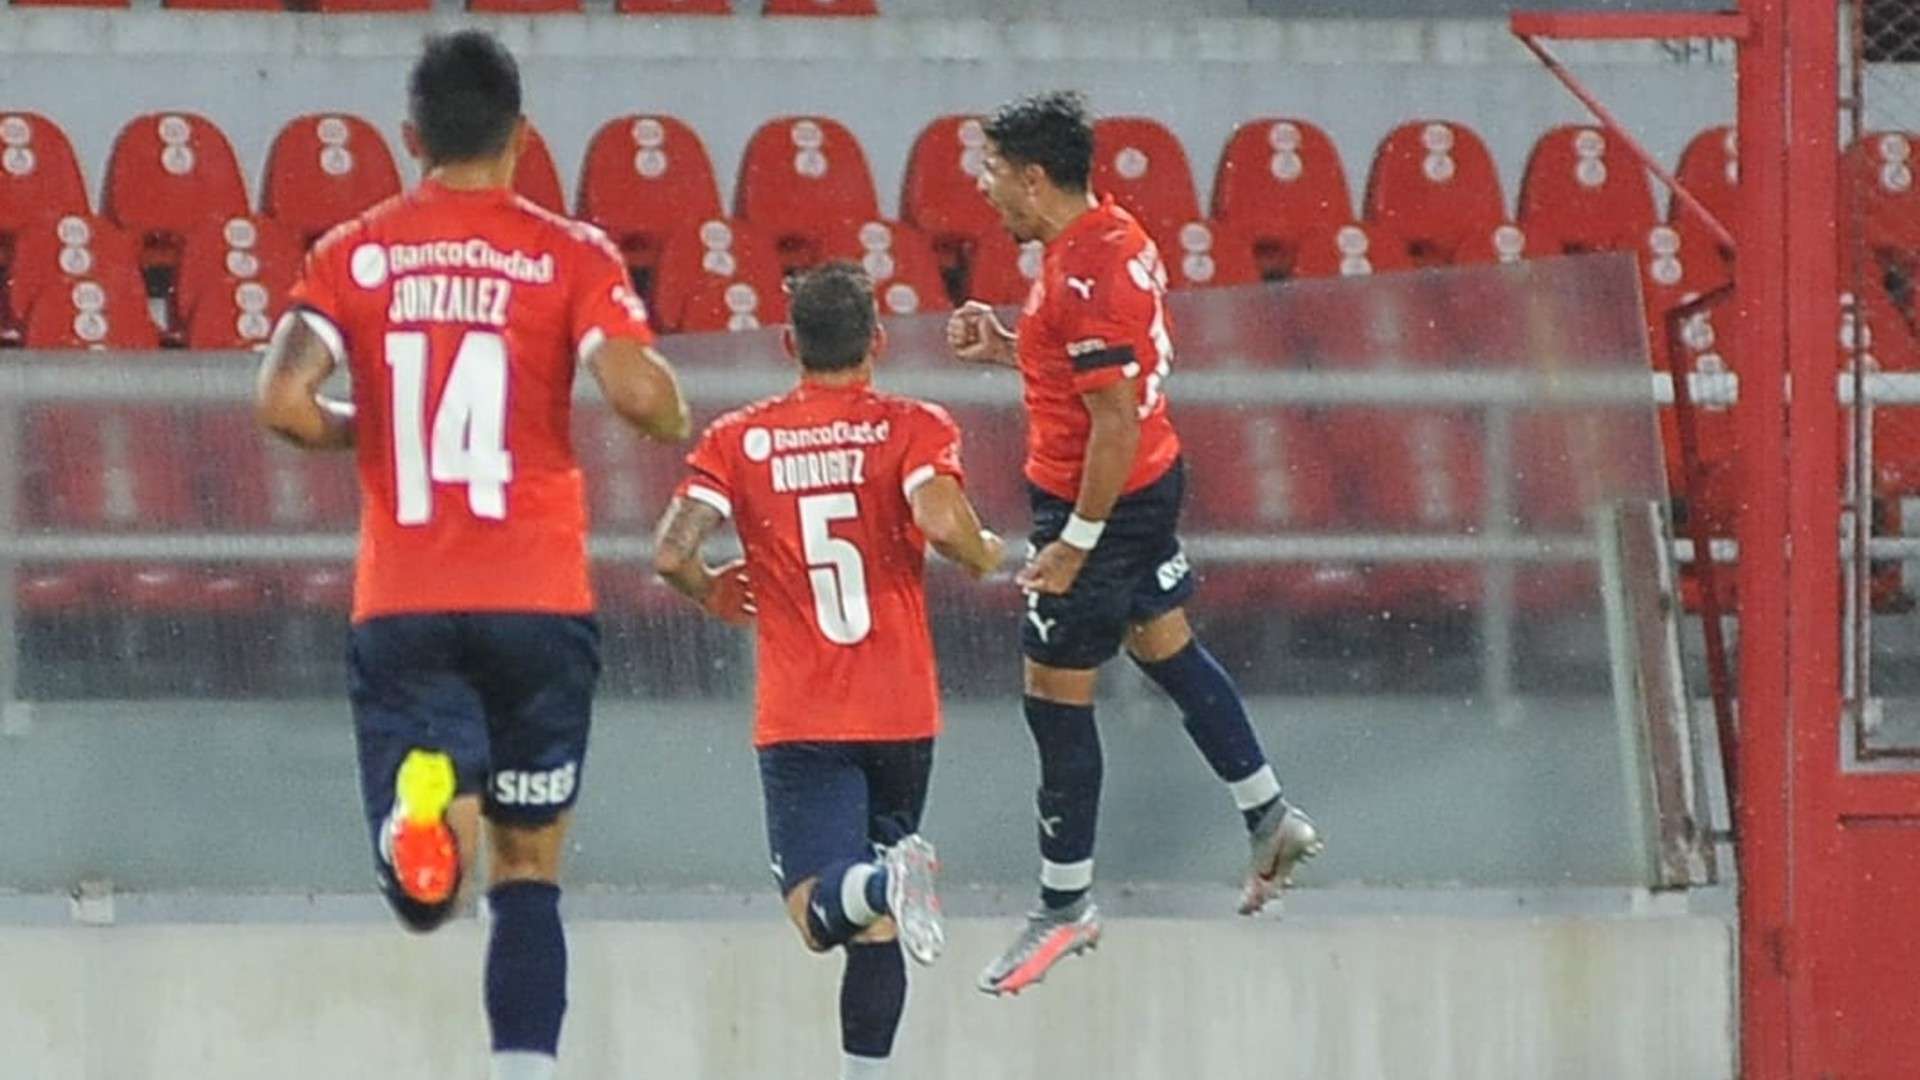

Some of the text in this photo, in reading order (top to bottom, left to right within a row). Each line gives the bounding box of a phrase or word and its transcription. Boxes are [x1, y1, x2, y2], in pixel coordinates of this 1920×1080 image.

[389, 238, 554, 284] BancoCiudad
[385, 331, 513, 525] 14
[798, 492, 872, 645] 5
